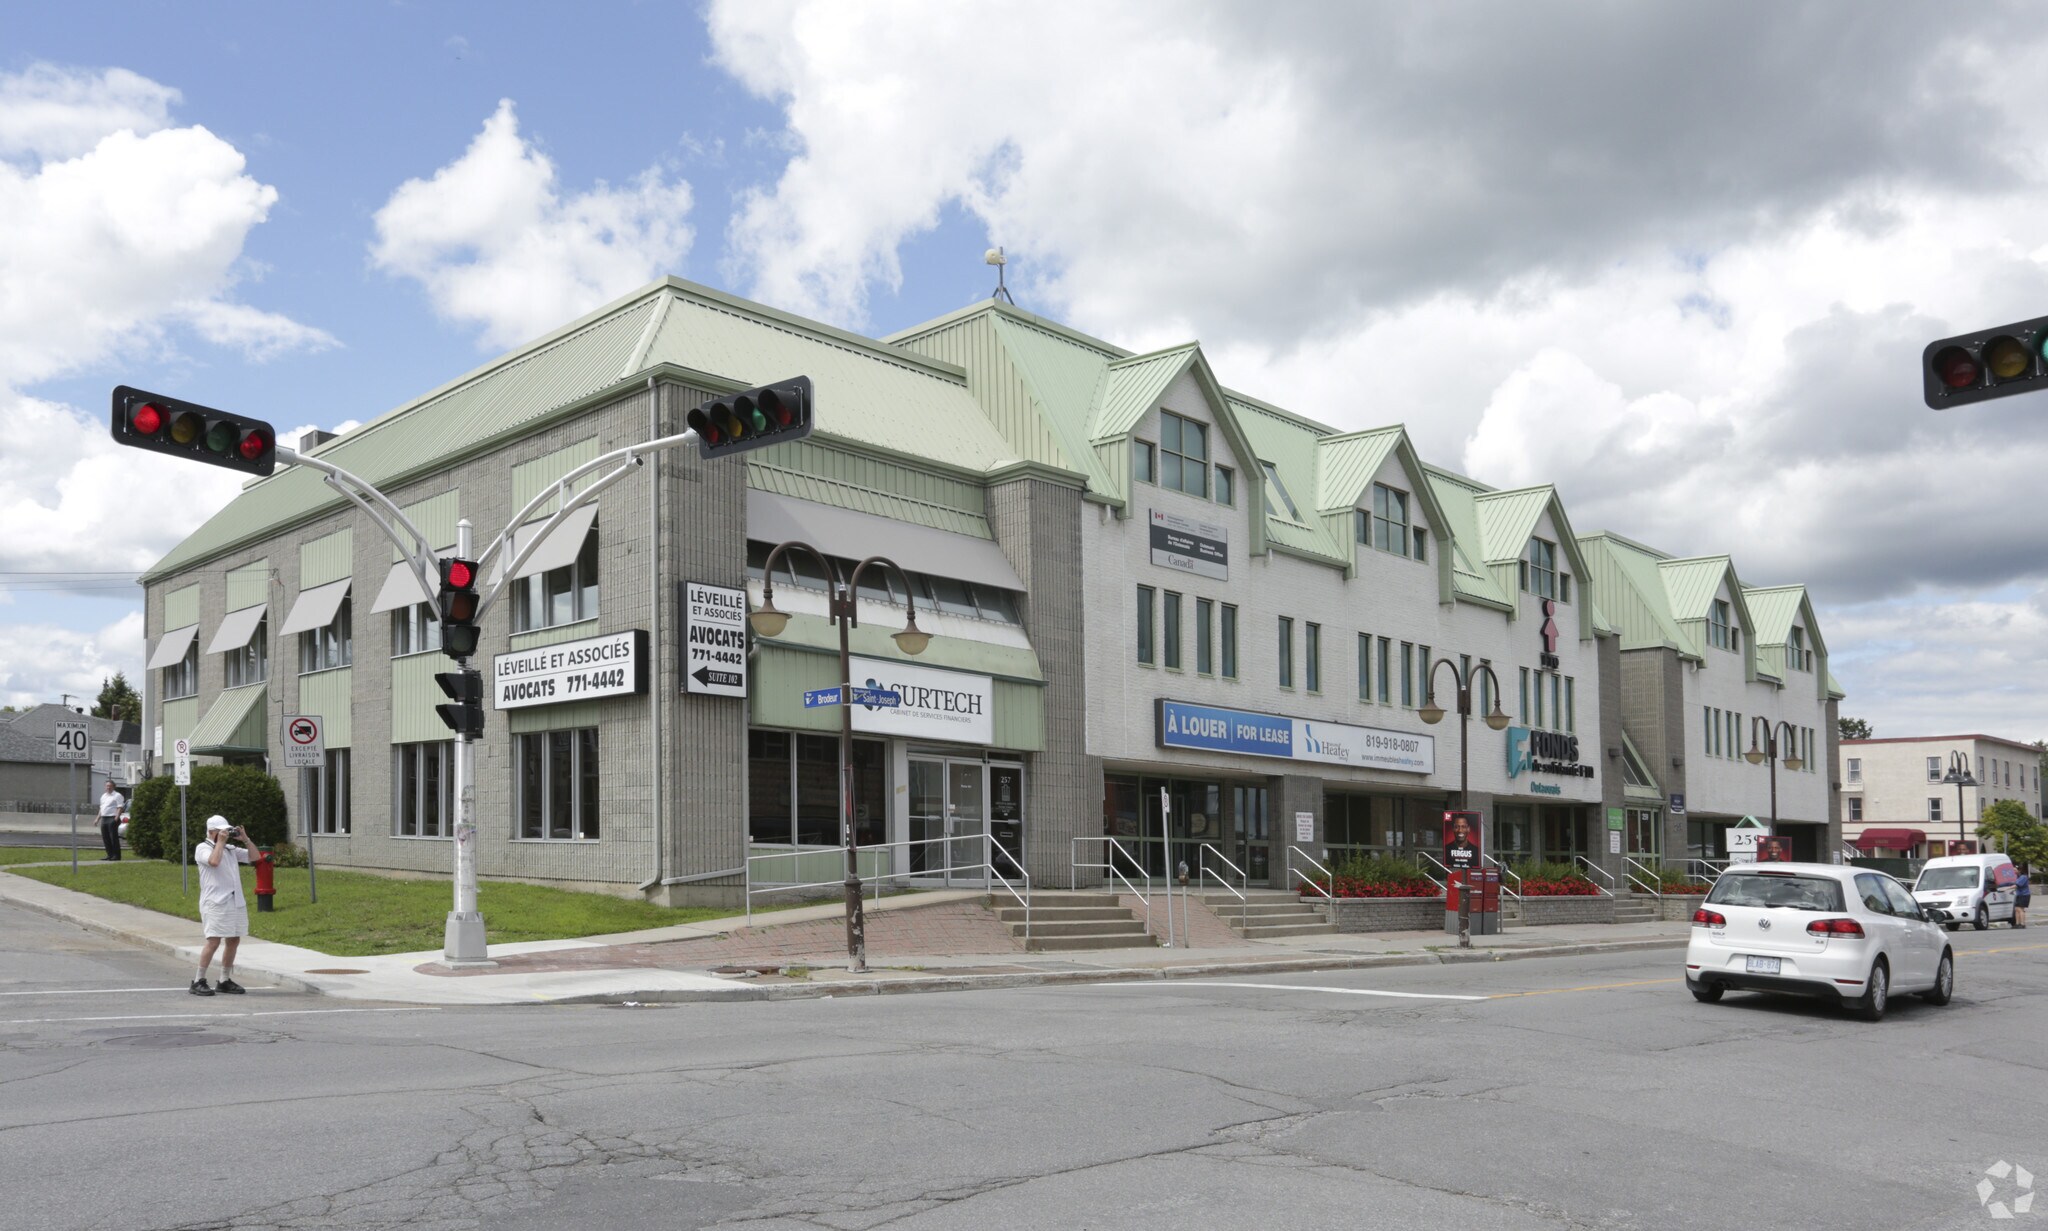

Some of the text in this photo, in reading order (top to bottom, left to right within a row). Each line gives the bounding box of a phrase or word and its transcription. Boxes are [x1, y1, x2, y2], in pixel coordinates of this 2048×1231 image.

[1168, 554, 1194, 569] Canada
[691, 587, 742, 609] LÉVEILLÉ
[693, 605, 742, 621] ET ASSOCIÉS
[689, 625, 744, 649] AVOCATS
[498, 638, 630, 676] LÉVEILLÉ ET ASSOCIÉS
[692, 648, 742, 665] 771-4442
[503, 668, 624, 701] AVOCATS 771-4442
[708, 672, 738, 684] SUITE 102
[817, 693, 838, 704] Brodeur
[863, 693, 896, 706] Saint-Joseph
[890, 708, 972, 723] CABINET DE SERVICES FINANCIERS
[1168, 708, 1227, 739] À LOUER
[57, 730, 87, 751] 40
[1237, 724, 1289, 744] FOR LEASE
[1321, 740, 1350, 757] Heafey
[1366, 734, 1419, 753] 819-918-0807
[1530, 730, 1579, 762] FONDS
[1000, 776, 1011, 784] 257
[1450, 849, 1472, 858] FERGUS
